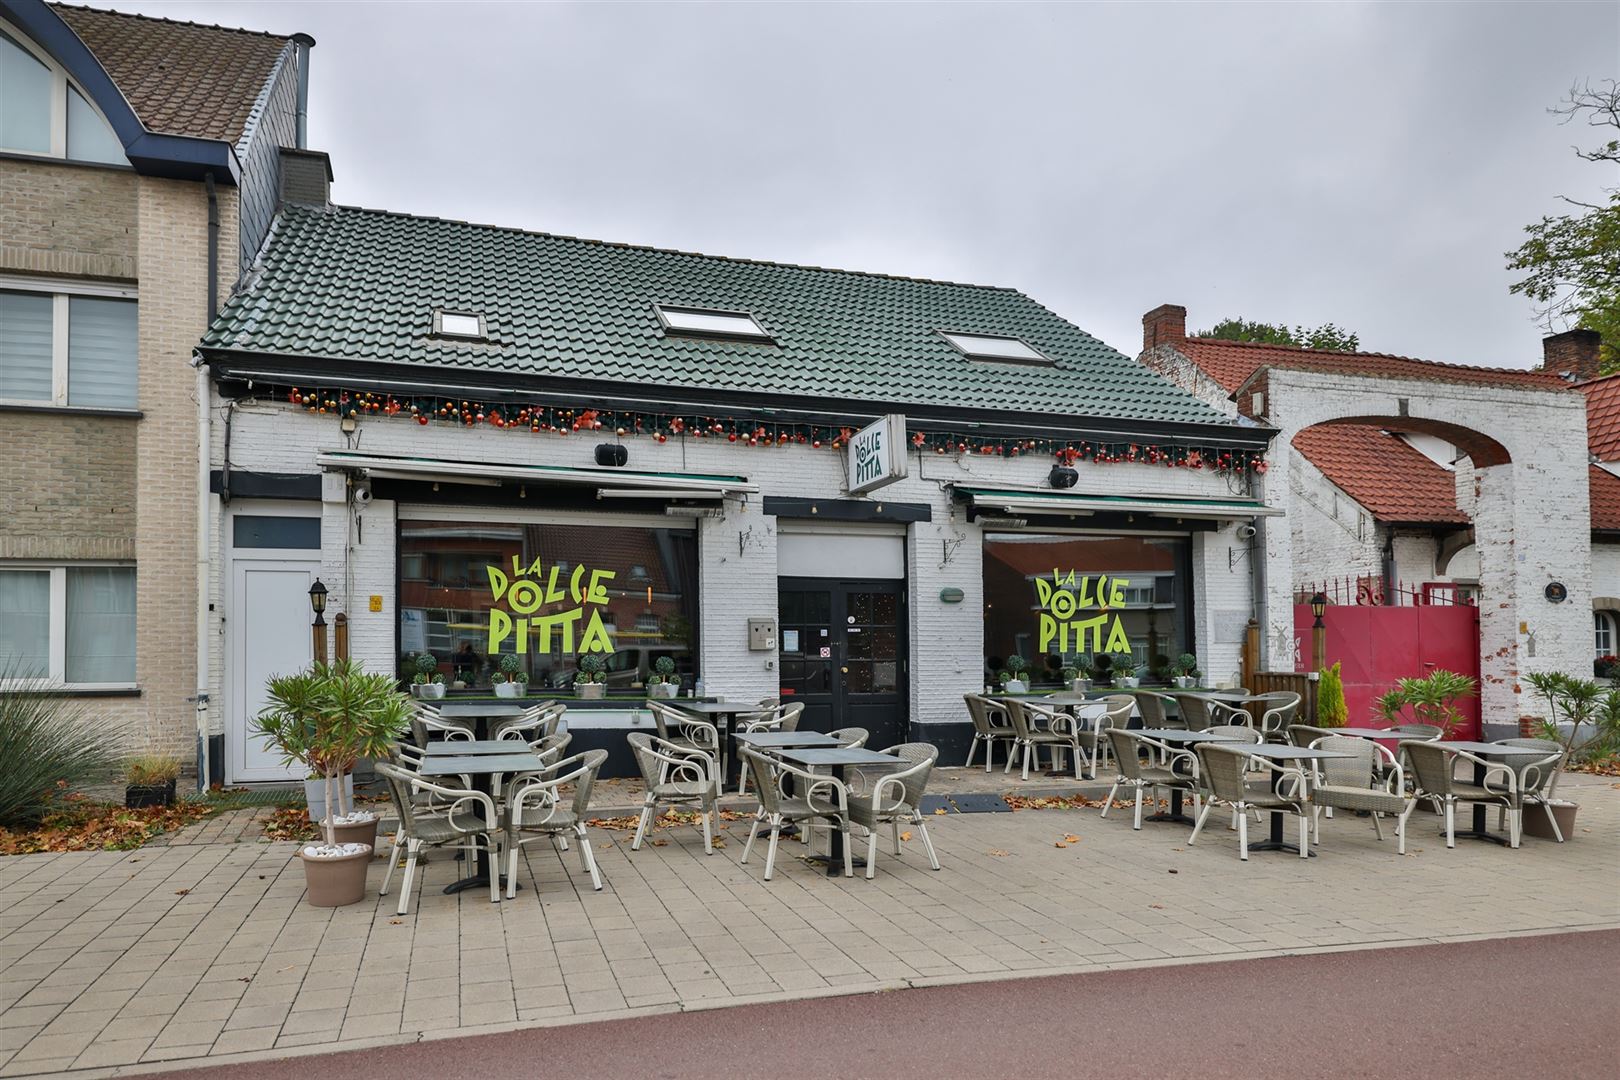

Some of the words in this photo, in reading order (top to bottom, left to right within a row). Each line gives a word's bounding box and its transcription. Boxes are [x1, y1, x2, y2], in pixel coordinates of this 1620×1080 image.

[859, 435, 866, 446] LA
[857, 454, 882, 485] PITTA
[512, 555, 541, 578] LA
[1053, 568, 1075, 587] LA
[487, 564, 616, 614] DOLCE
[1035, 574, 1129, 619] DOLCE
[488, 607, 615, 654] PITTA
[1040, 613, 1131, 653] PITTA
